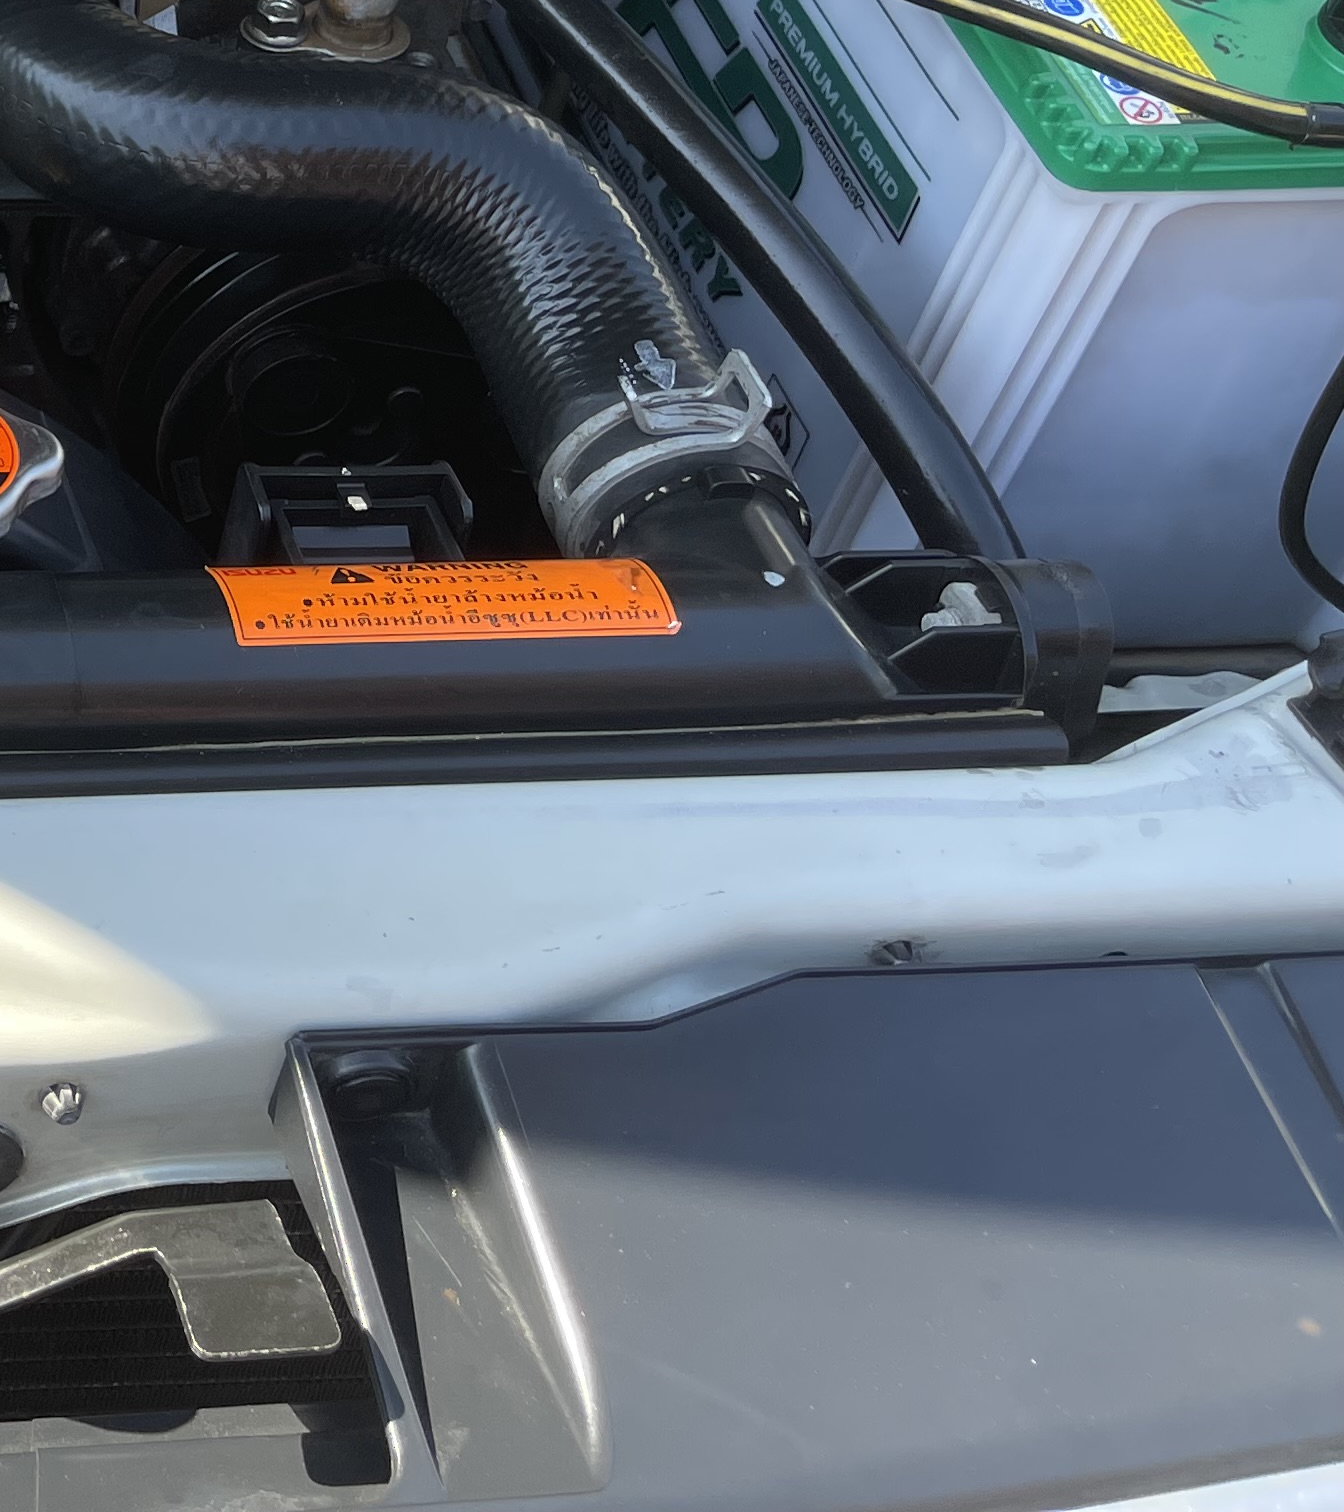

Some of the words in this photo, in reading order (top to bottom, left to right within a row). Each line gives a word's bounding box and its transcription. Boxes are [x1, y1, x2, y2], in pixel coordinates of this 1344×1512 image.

[768, 58, 815, 130] JAPANESE
[808, 121, 866, 211] TECHNOLOGY
[836, 103, 899, 201] HYBRID
[222, 567, 297, 577] ISUZU
[371, 560, 529, 573] WARNING
